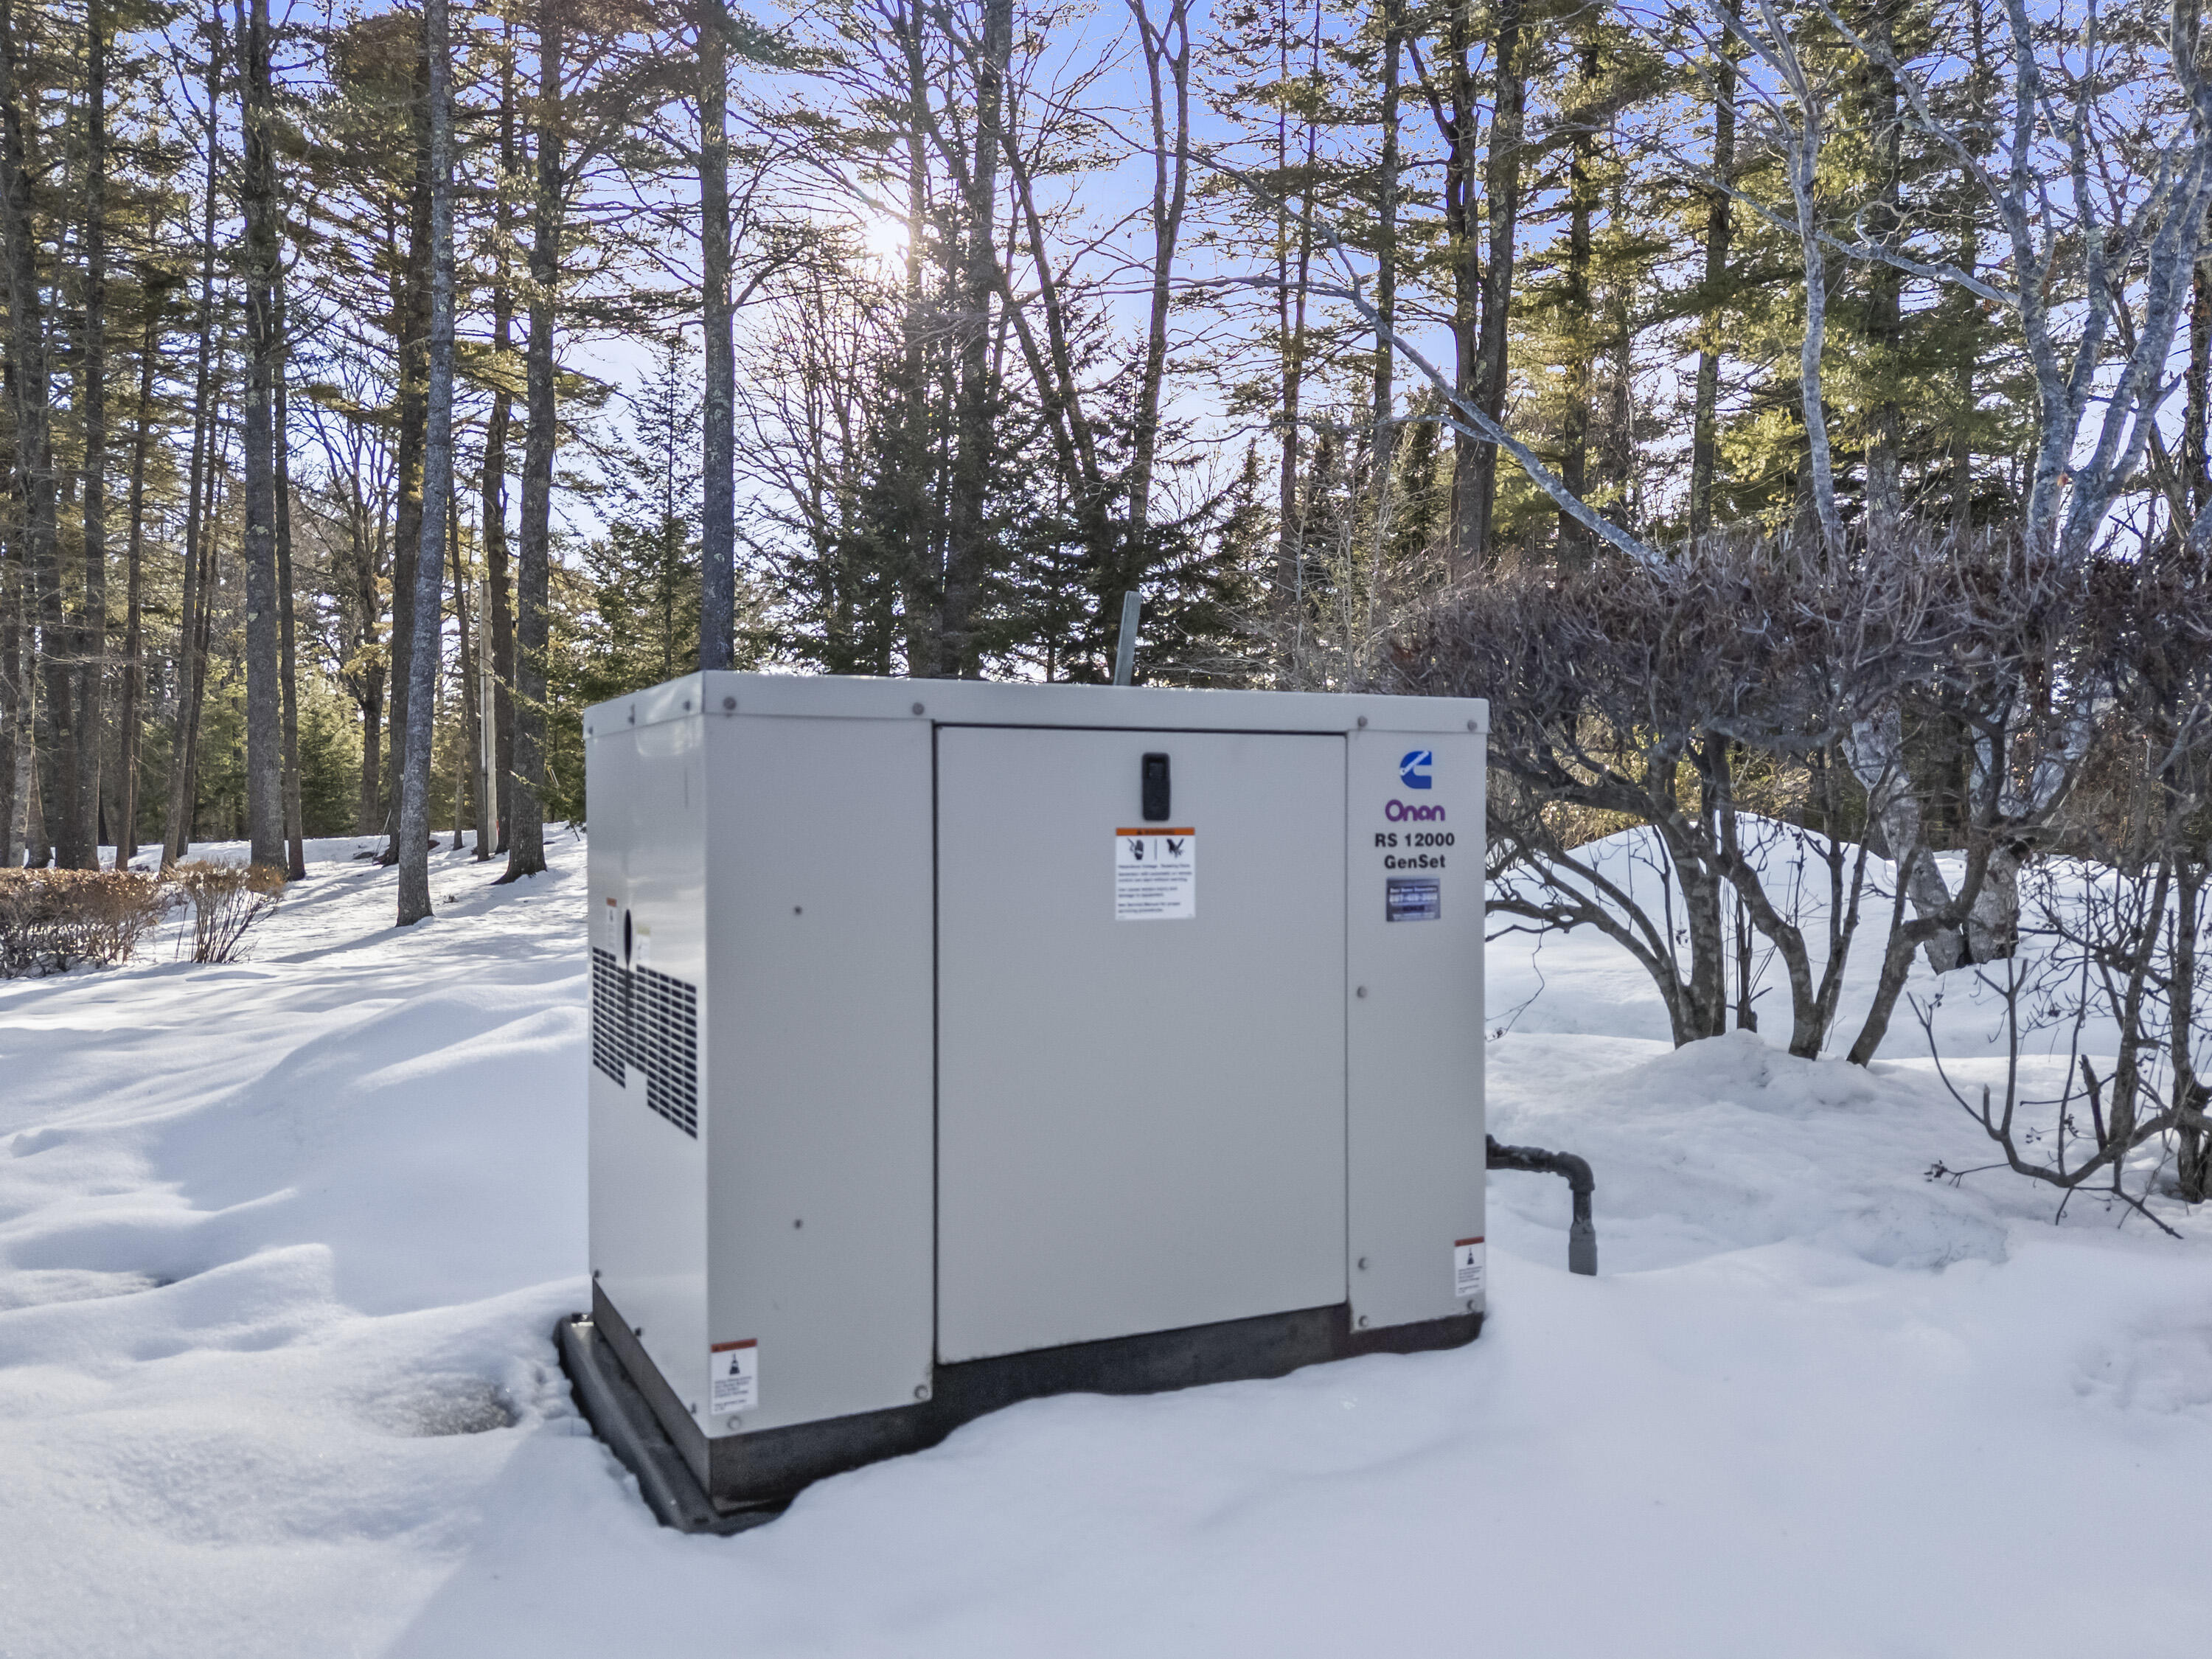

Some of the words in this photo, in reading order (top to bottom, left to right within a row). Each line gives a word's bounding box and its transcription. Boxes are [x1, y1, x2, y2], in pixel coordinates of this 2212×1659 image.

[1385, 799, 1445, 822] Onan
[1375, 832, 1398, 847] RS
[1405, 832, 1455, 847] 12000
[1384, 854, 1446, 869] GenSet
